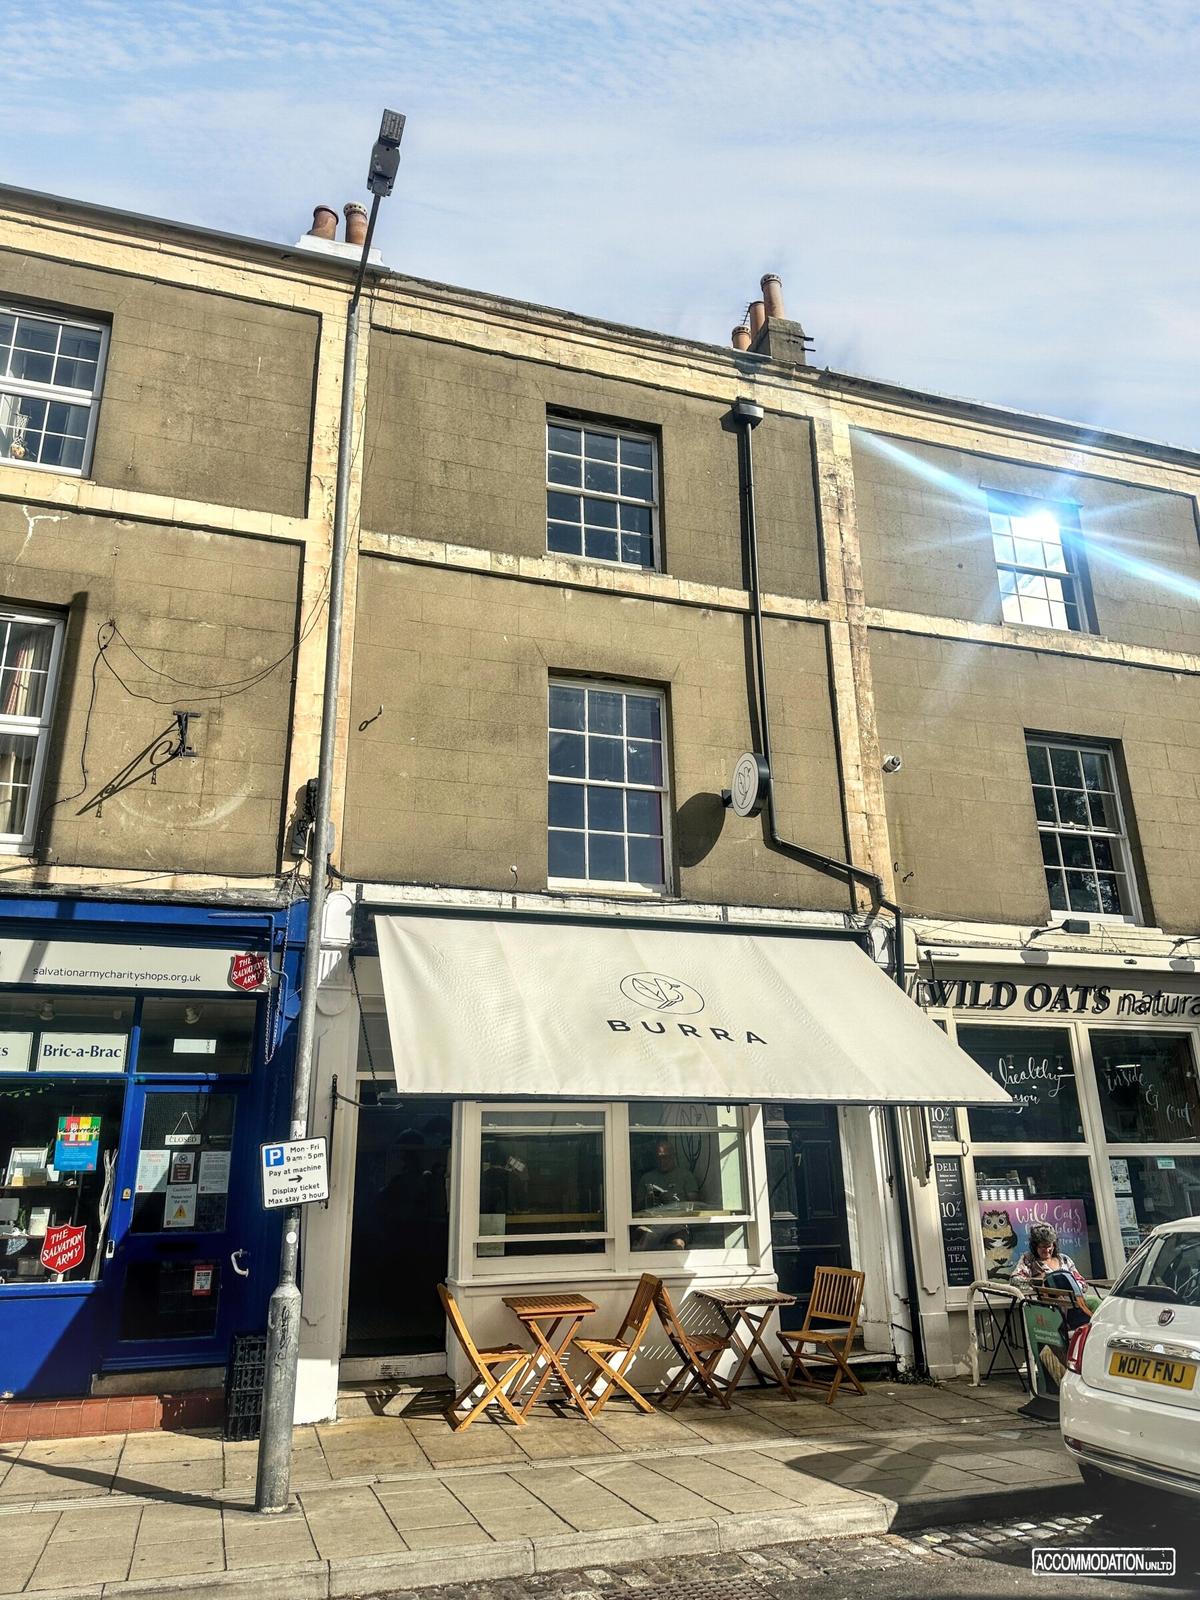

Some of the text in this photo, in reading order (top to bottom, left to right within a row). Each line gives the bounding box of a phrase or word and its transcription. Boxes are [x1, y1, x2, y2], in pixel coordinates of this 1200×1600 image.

[239, 957, 253, 967] THE
[33, 967, 201, 983] salvationarmycharityshops.org.uk
[926, 979, 1018, 1011] WILD
[1025, 983, 1111, 1013] OATS
[607, 1019, 768, 1045] BURRA
[43, 1044, 122, 1058] Bric-a-Brac
[310, 1143, 320, 1151] Fri
[269, 1149, 282, 1165] P
[794, 1153, 802, 1167] 7
[292, 1164, 321, 1173] machine
[936, 1163, 958, 1171] DELI
[272, 1182, 320, 1195] Display ticket
[268, 1197, 283, 1205] Max
[285, 1195, 300, 1203] stay
[309, 1191, 325, 1199] hour
[1015, 1202, 1048, 1224] Wild
[50, 1228, 69, 1242] THE
[42, 1232, 83, 1262] SALVATION
[56, 1247, 80, 1266] ARMY
[948, 1254, 967, 1263] TEA
[1117, 1355, 1186, 1383] WO17 FNJ
